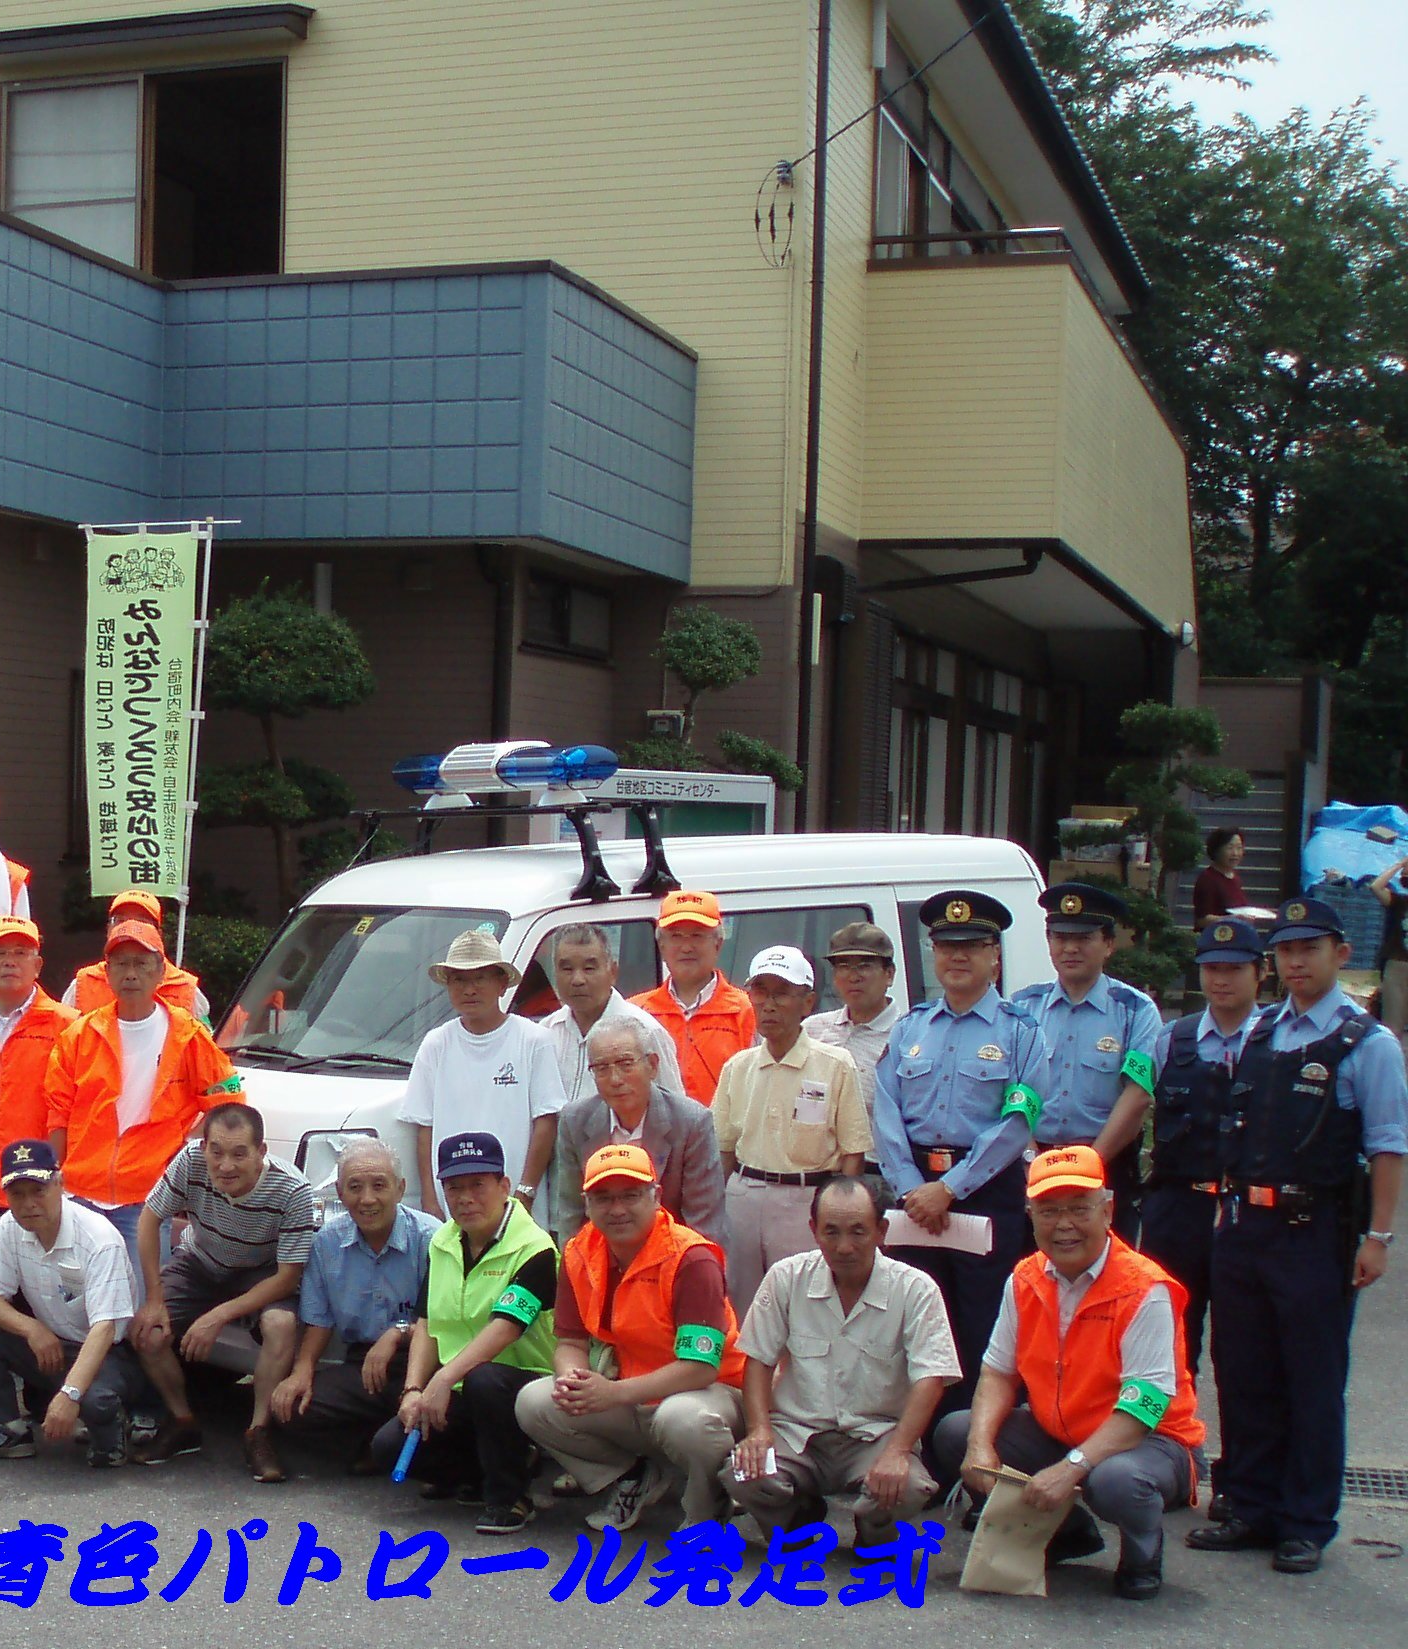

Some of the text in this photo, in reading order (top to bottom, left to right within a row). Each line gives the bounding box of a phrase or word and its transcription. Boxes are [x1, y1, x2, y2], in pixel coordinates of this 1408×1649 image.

[1127, 1058, 1147, 1077] 安全
[516, 1297, 536, 1317] 安全
[1138, 1394, 1164, 1419] 安全
